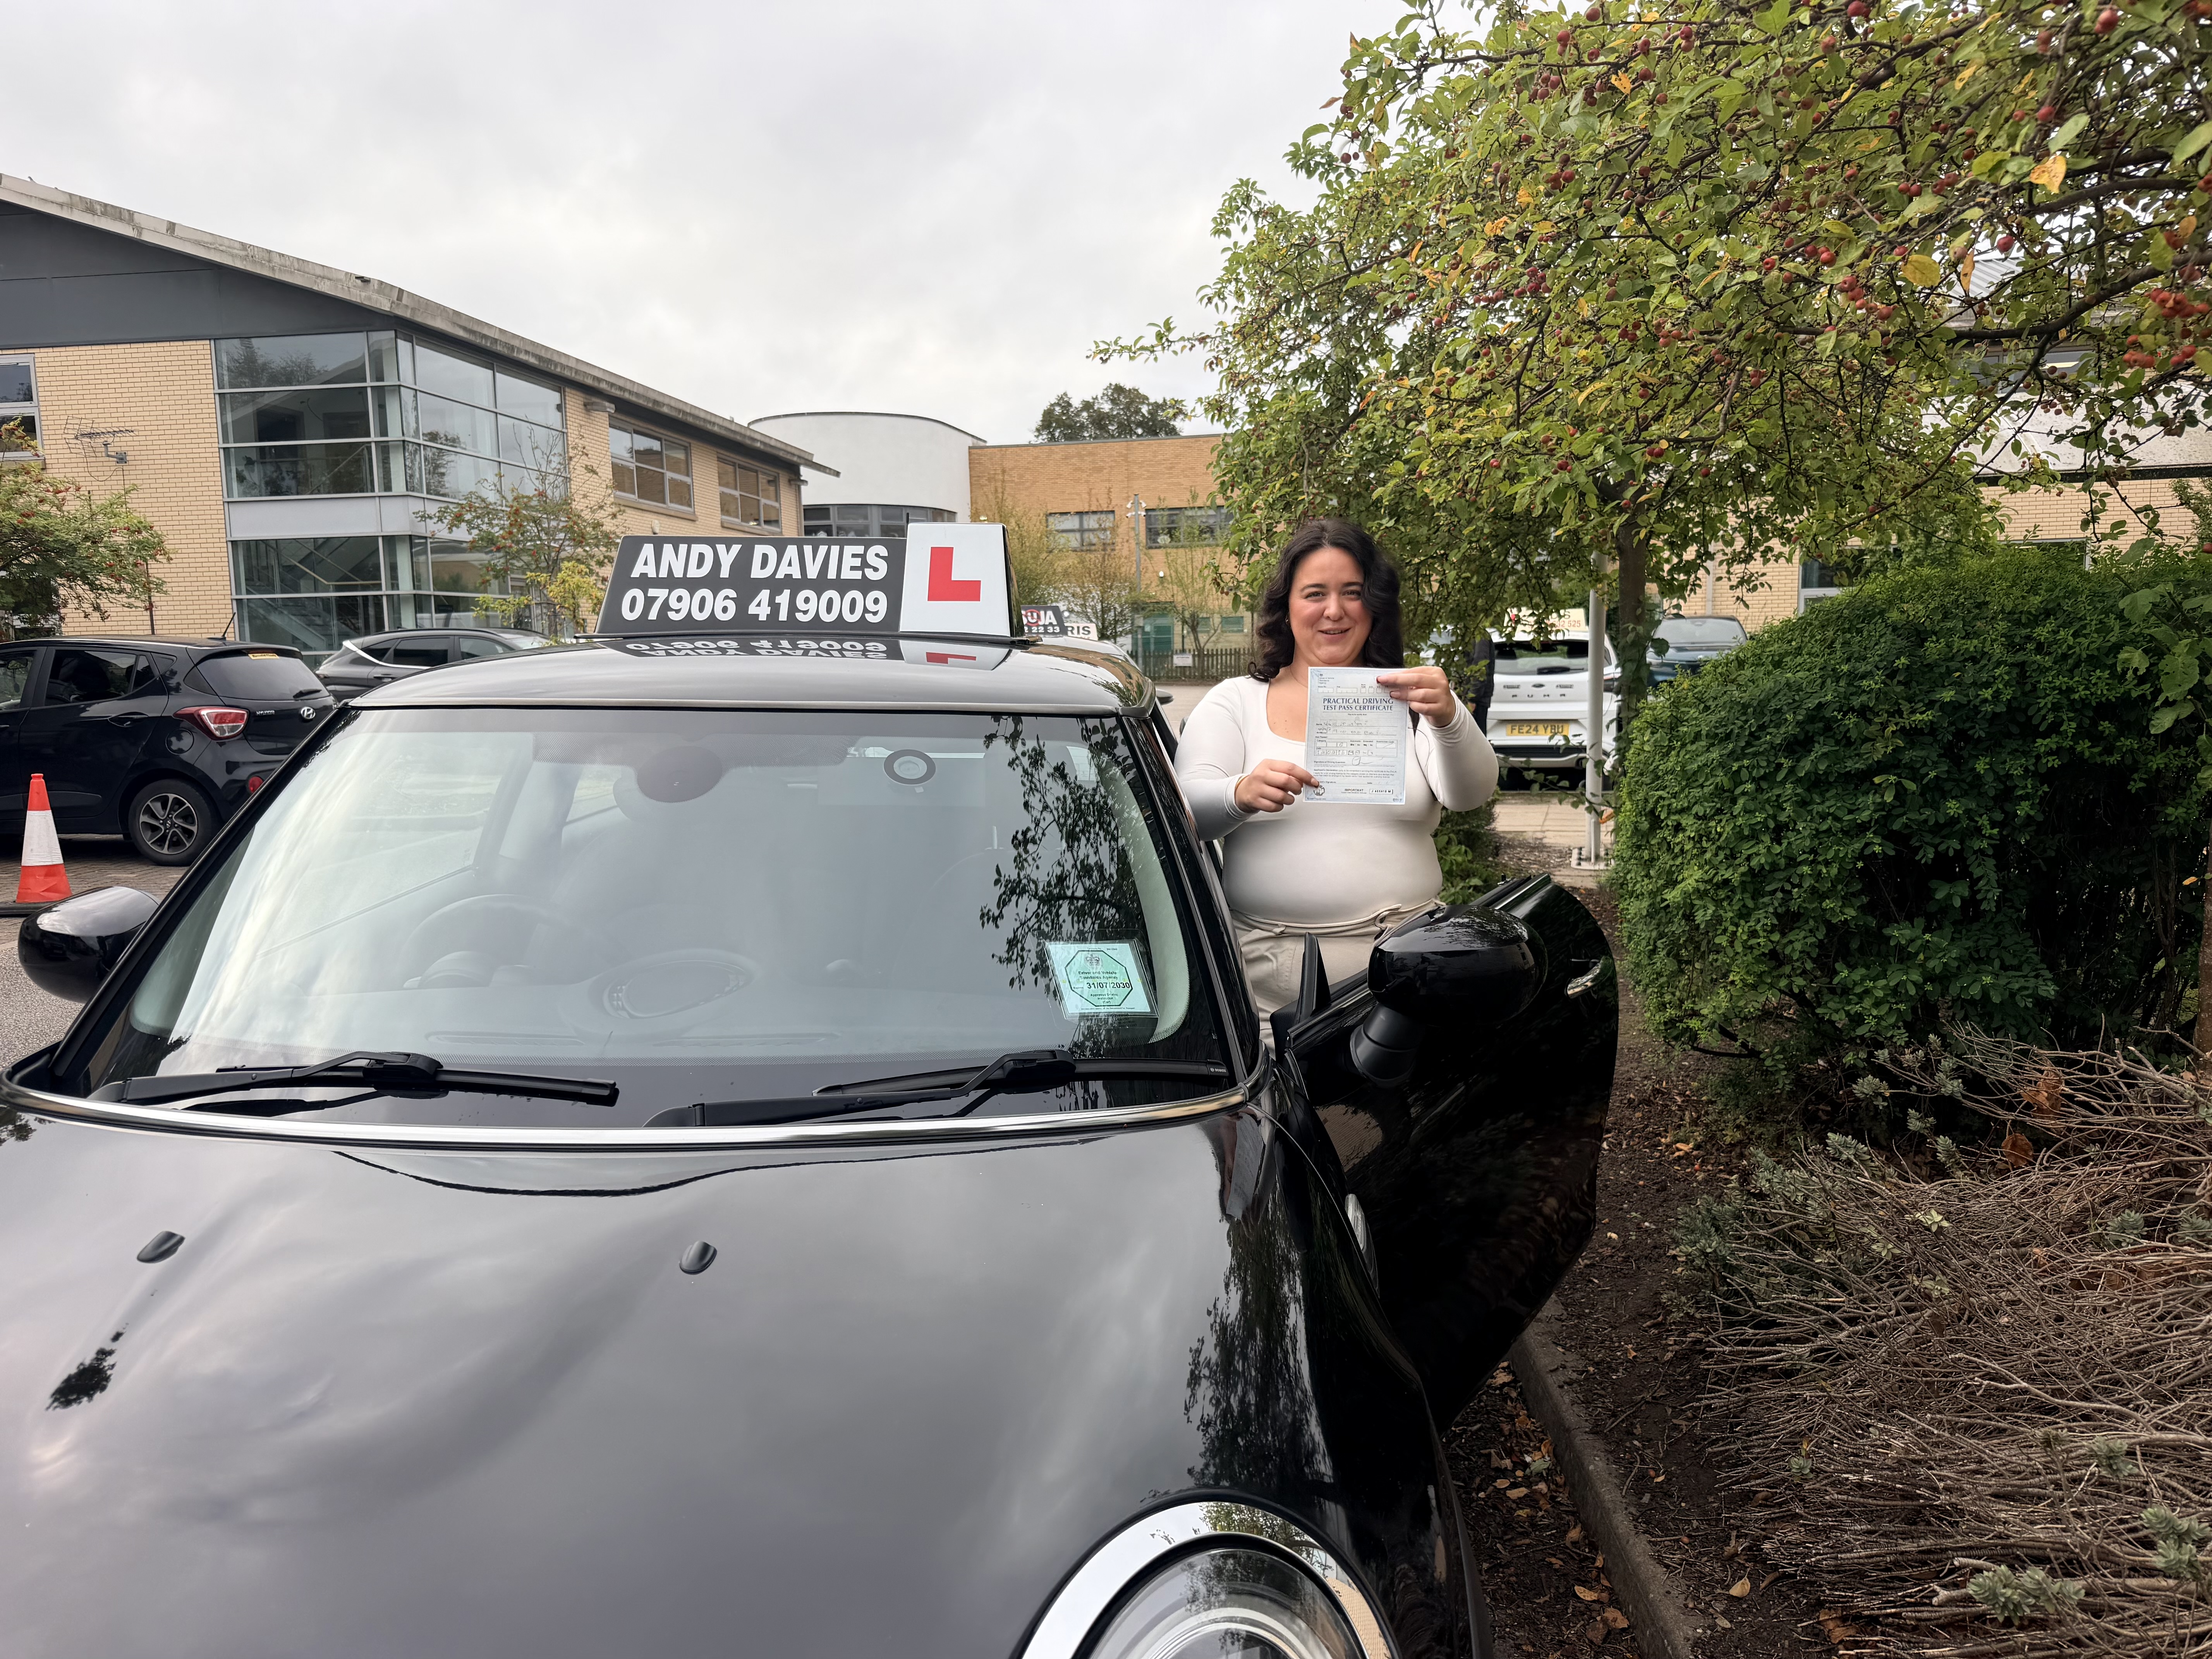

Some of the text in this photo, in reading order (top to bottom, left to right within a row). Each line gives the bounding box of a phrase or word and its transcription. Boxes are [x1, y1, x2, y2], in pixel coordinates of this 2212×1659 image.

[631, 543, 888, 580] ANDY DAVIES
[928, 547, 981, 601] L
[622, 588, 887, 623] 07906 419009
[1511, 725, 1539, 734] FE24
